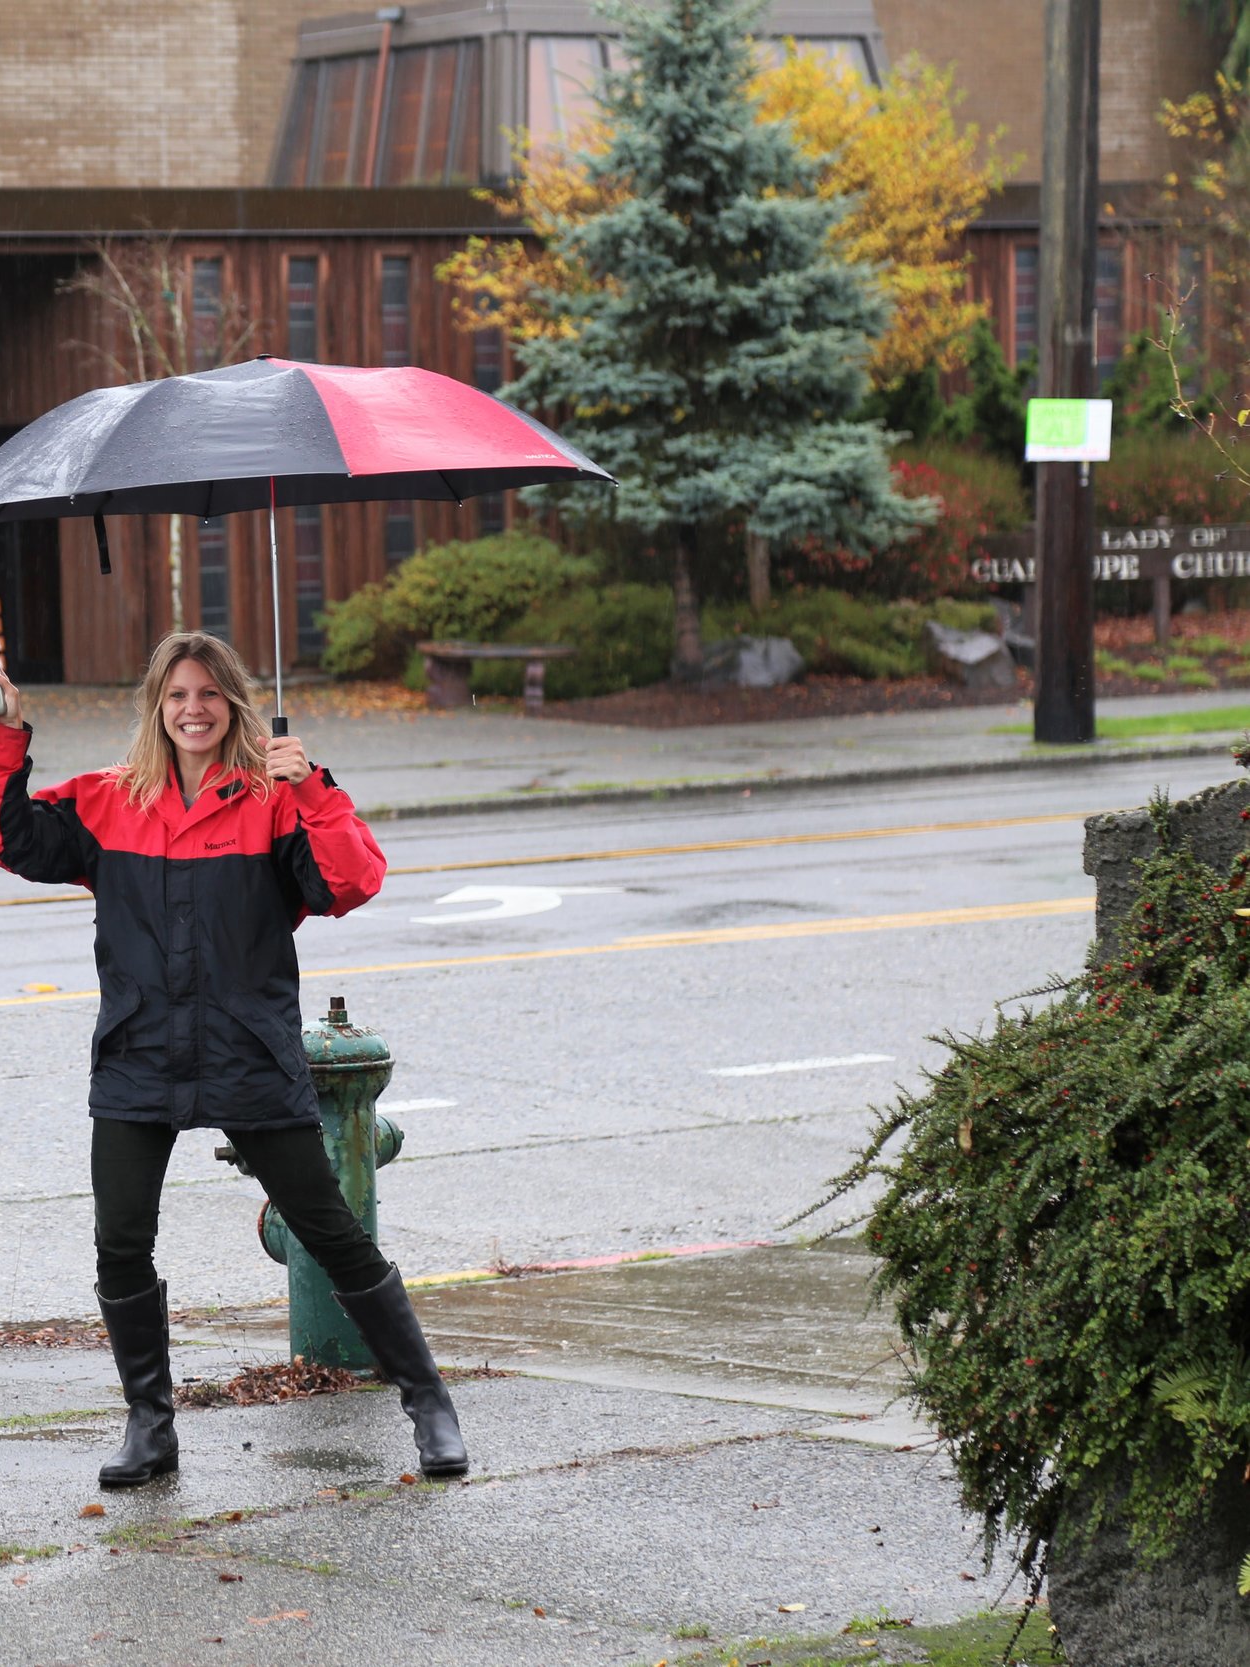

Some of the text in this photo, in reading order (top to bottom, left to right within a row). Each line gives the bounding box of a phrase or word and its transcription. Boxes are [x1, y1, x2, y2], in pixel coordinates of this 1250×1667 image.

[1102, 527, 1227, 550] LADY OF
[204, 839, 236, 850] Marmot
